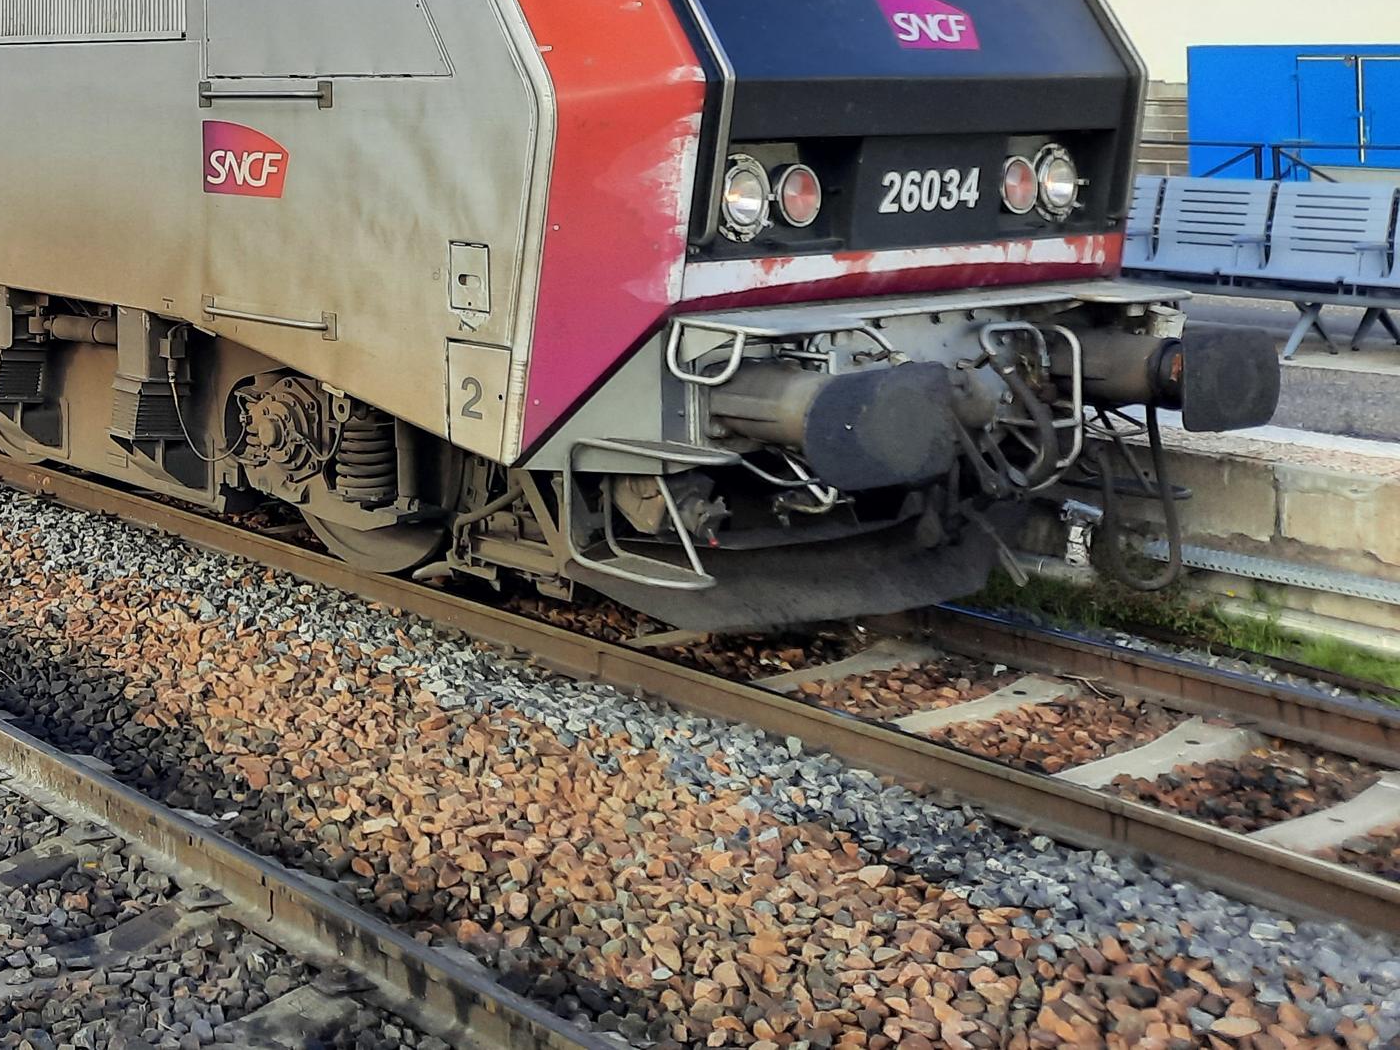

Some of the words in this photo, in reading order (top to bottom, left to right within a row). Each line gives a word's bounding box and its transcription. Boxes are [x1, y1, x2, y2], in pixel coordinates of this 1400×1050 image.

[893, 12, 966, 42] SNCF
[207, 150, 282, 187] SNCF
[878, 167, 980, 213] 26034
[461, 377, 483, 420] 2
